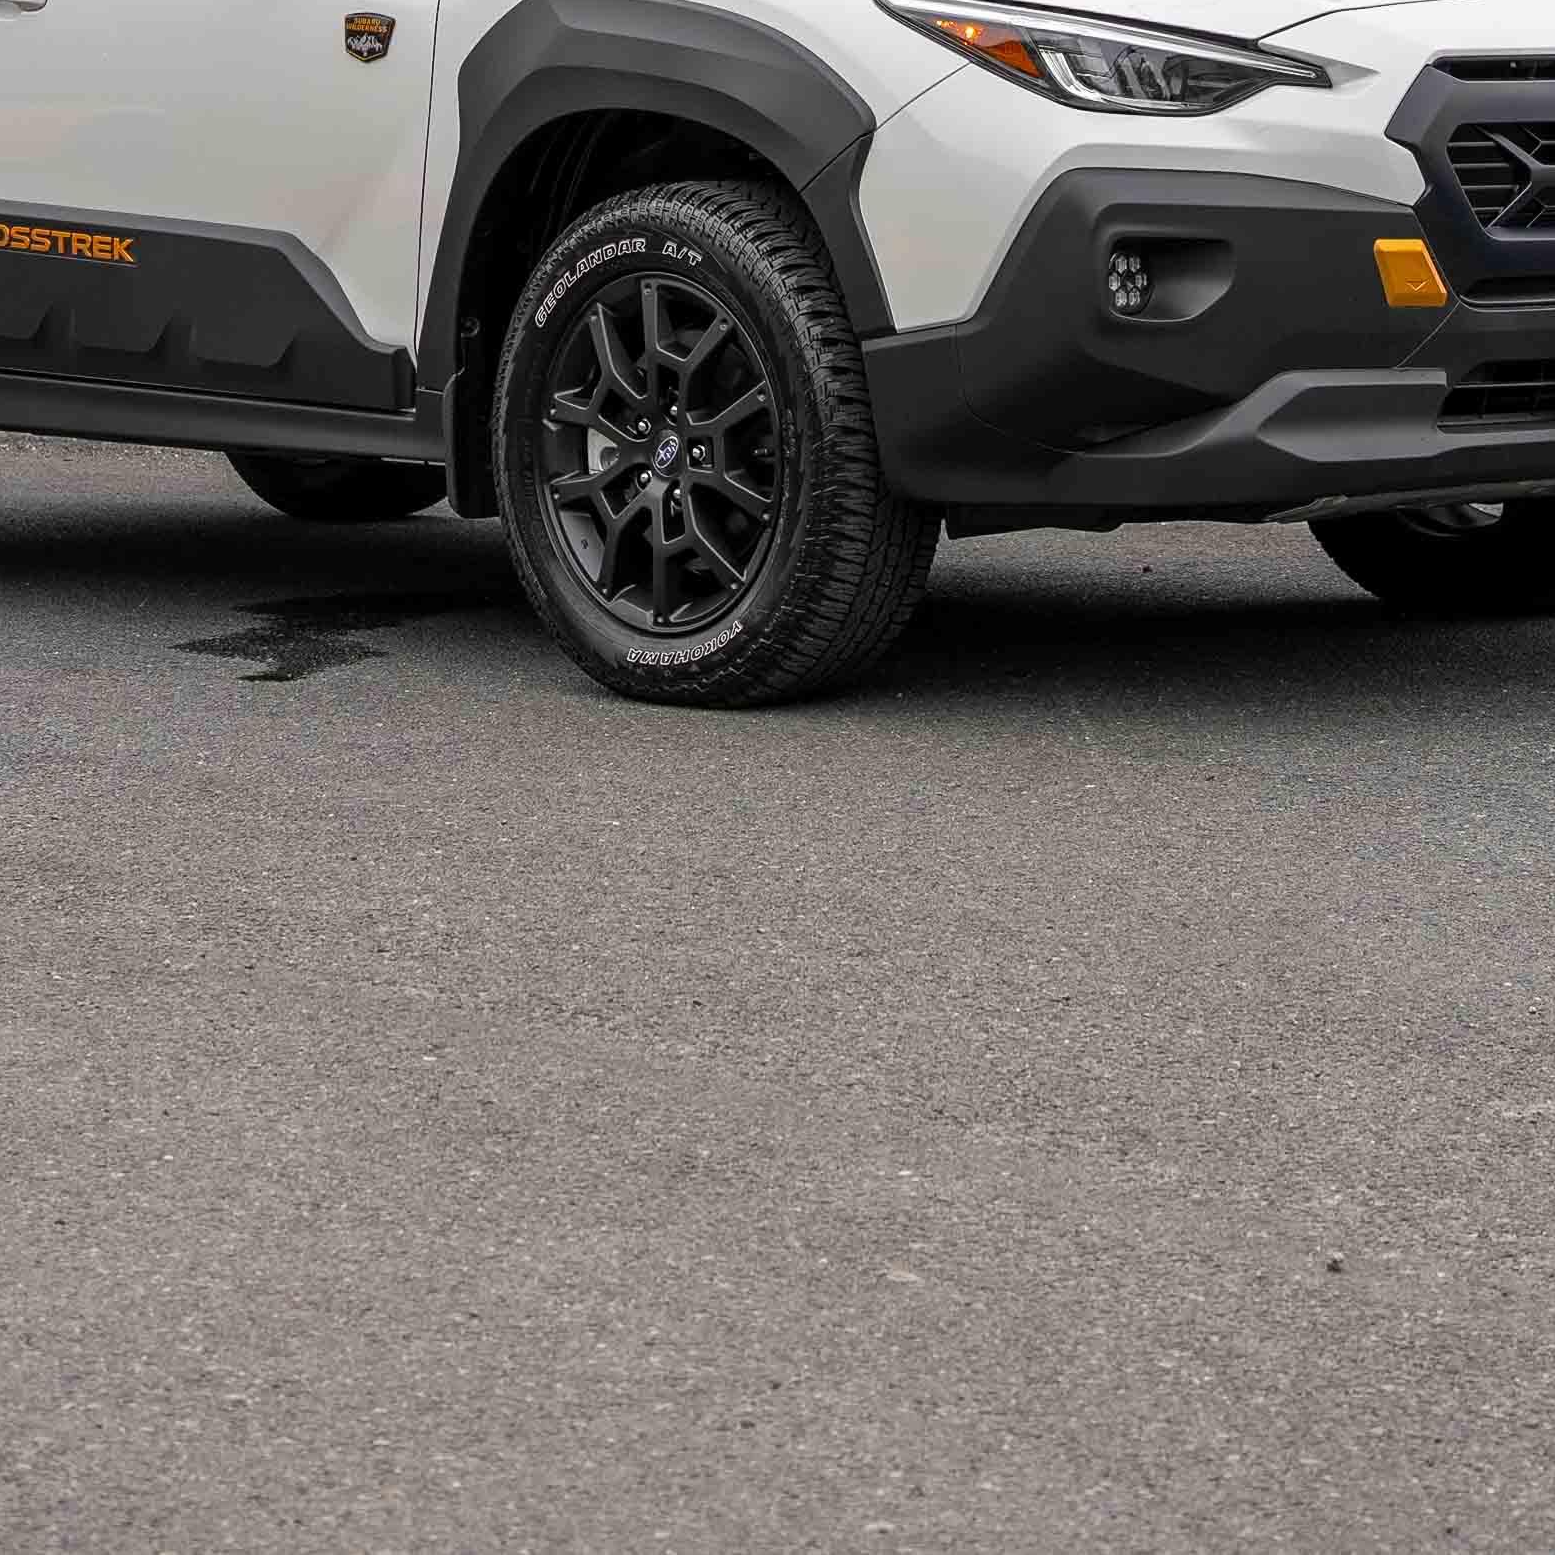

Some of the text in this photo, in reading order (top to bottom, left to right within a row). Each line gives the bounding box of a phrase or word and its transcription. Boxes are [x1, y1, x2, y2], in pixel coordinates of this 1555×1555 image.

[533, 238, 703, 329] GEOLANDAR A/T
[626, 619, 743, 665] YOKOHAMA
